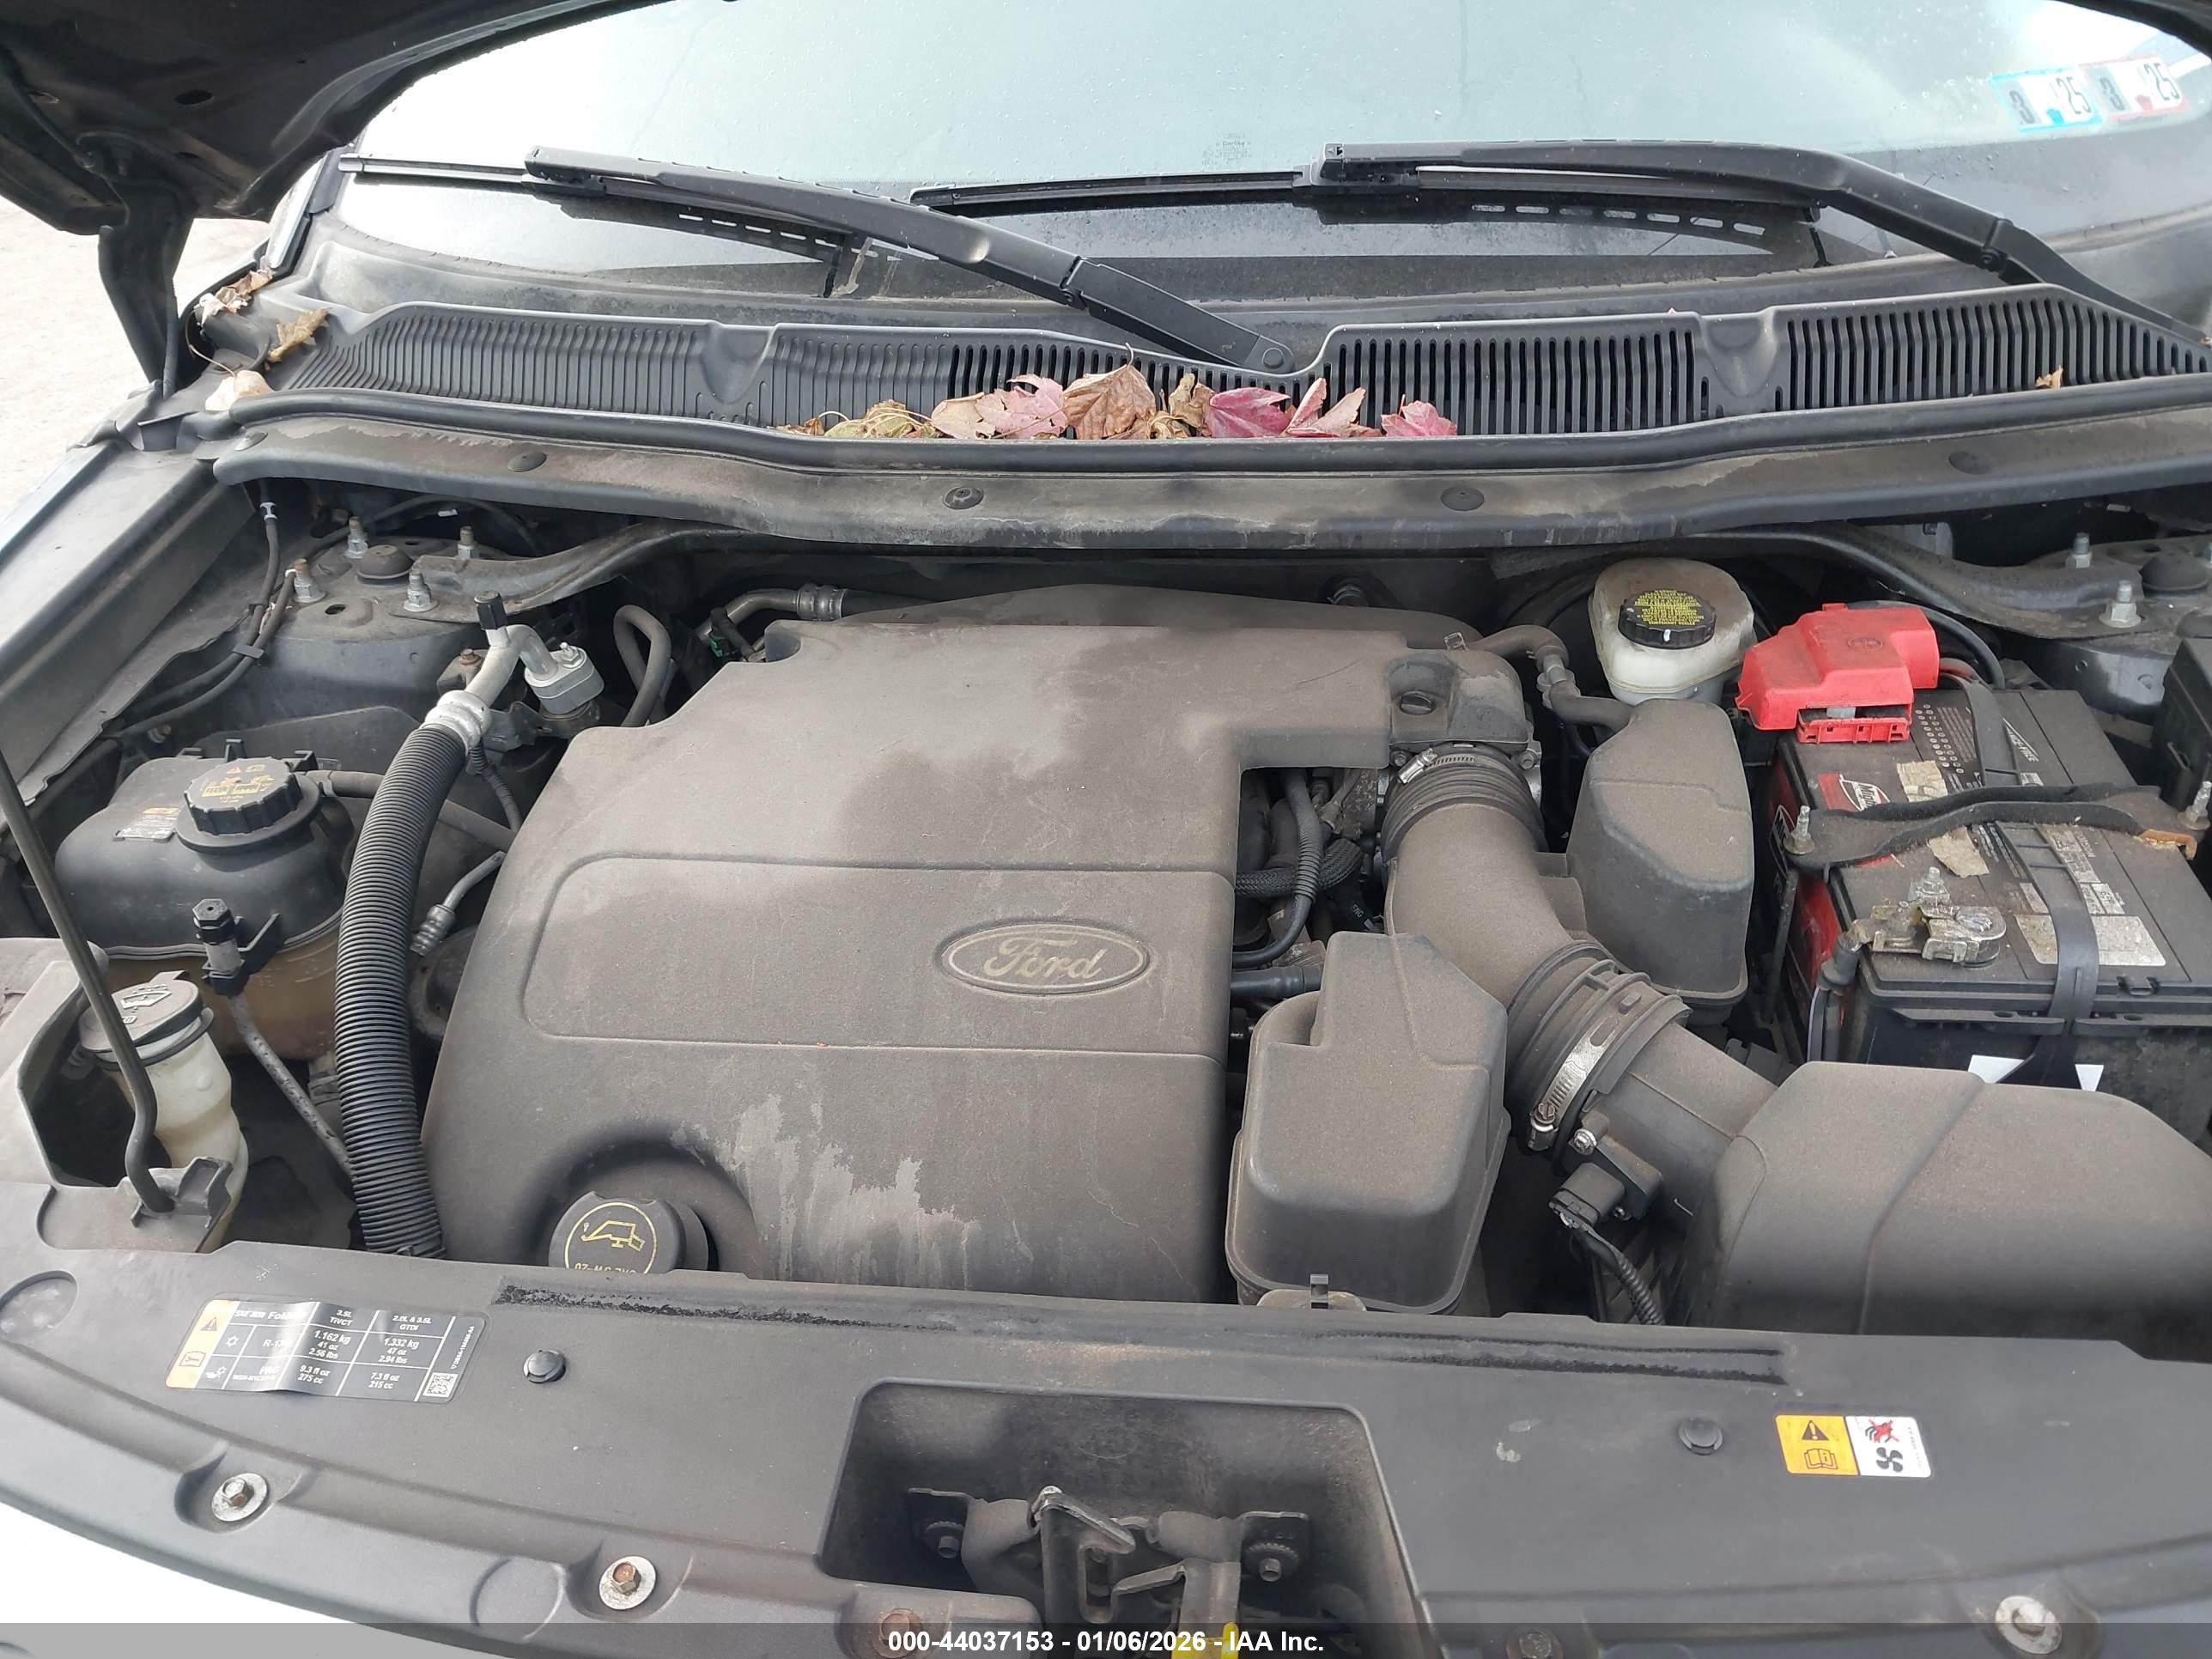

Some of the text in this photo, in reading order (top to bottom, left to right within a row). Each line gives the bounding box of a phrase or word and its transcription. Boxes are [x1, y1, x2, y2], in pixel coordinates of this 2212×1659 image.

[2143, 62, 2180, 100] 25
[2056, 76, 2092, 115] 25
[983, 936, 1109, 980] Ford
[338, 1333, 351, 1345] kg
[407, 1340, 420, 1349] kg
[297, 1373, 314, 1382] 275
